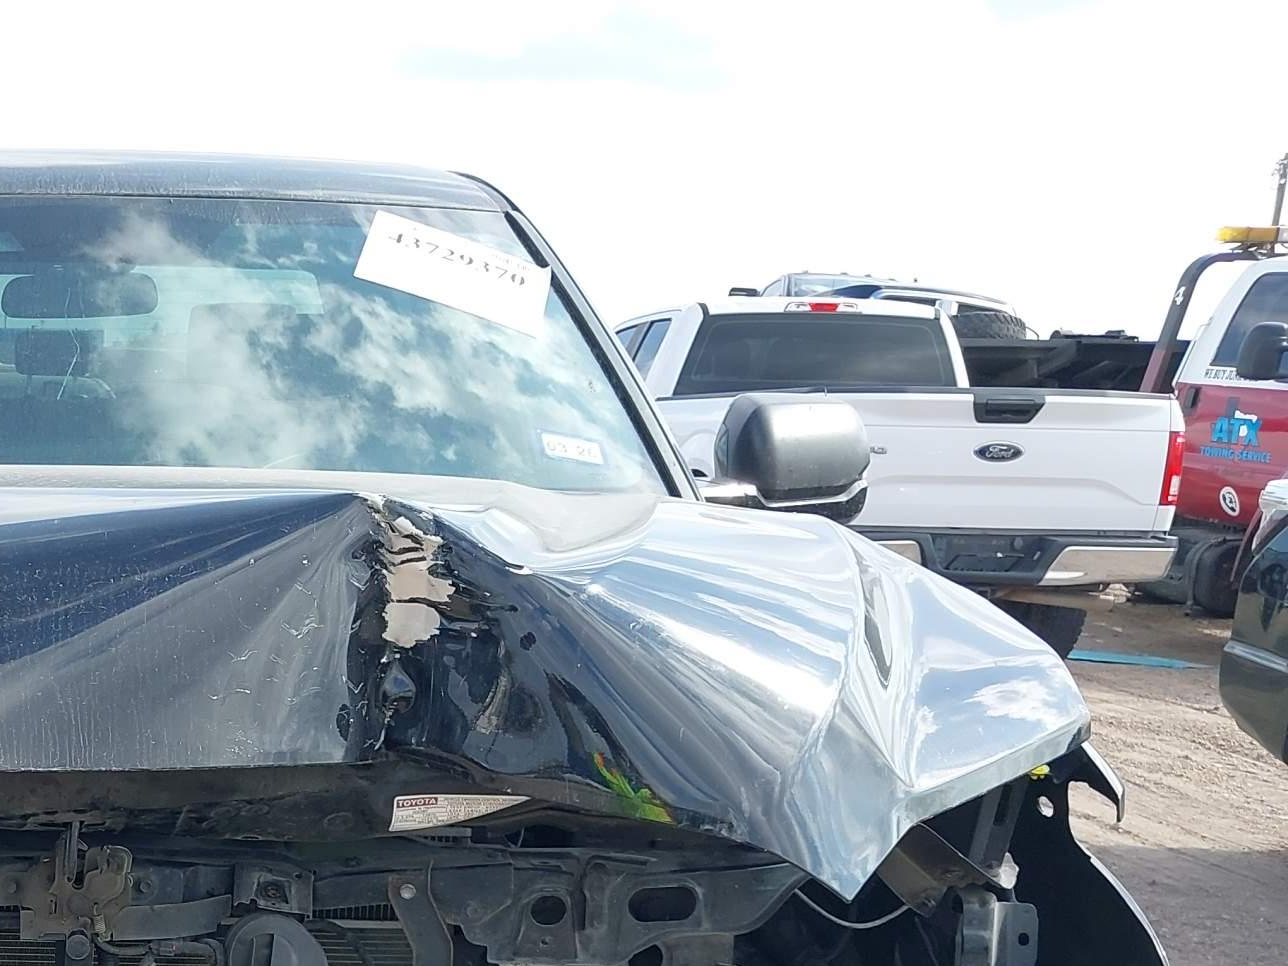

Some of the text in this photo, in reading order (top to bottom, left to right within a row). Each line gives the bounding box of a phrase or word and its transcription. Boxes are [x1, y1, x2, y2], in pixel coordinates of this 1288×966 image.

[388, 232, 526, 287] 43729370
[1211, 416, 1262, 448] ATX
[985, 445, 1015, 459] Ford
[1200, 446, 1273, 463] TOWING SERVICE
[398, 798, 437, 807] TOYOTA
